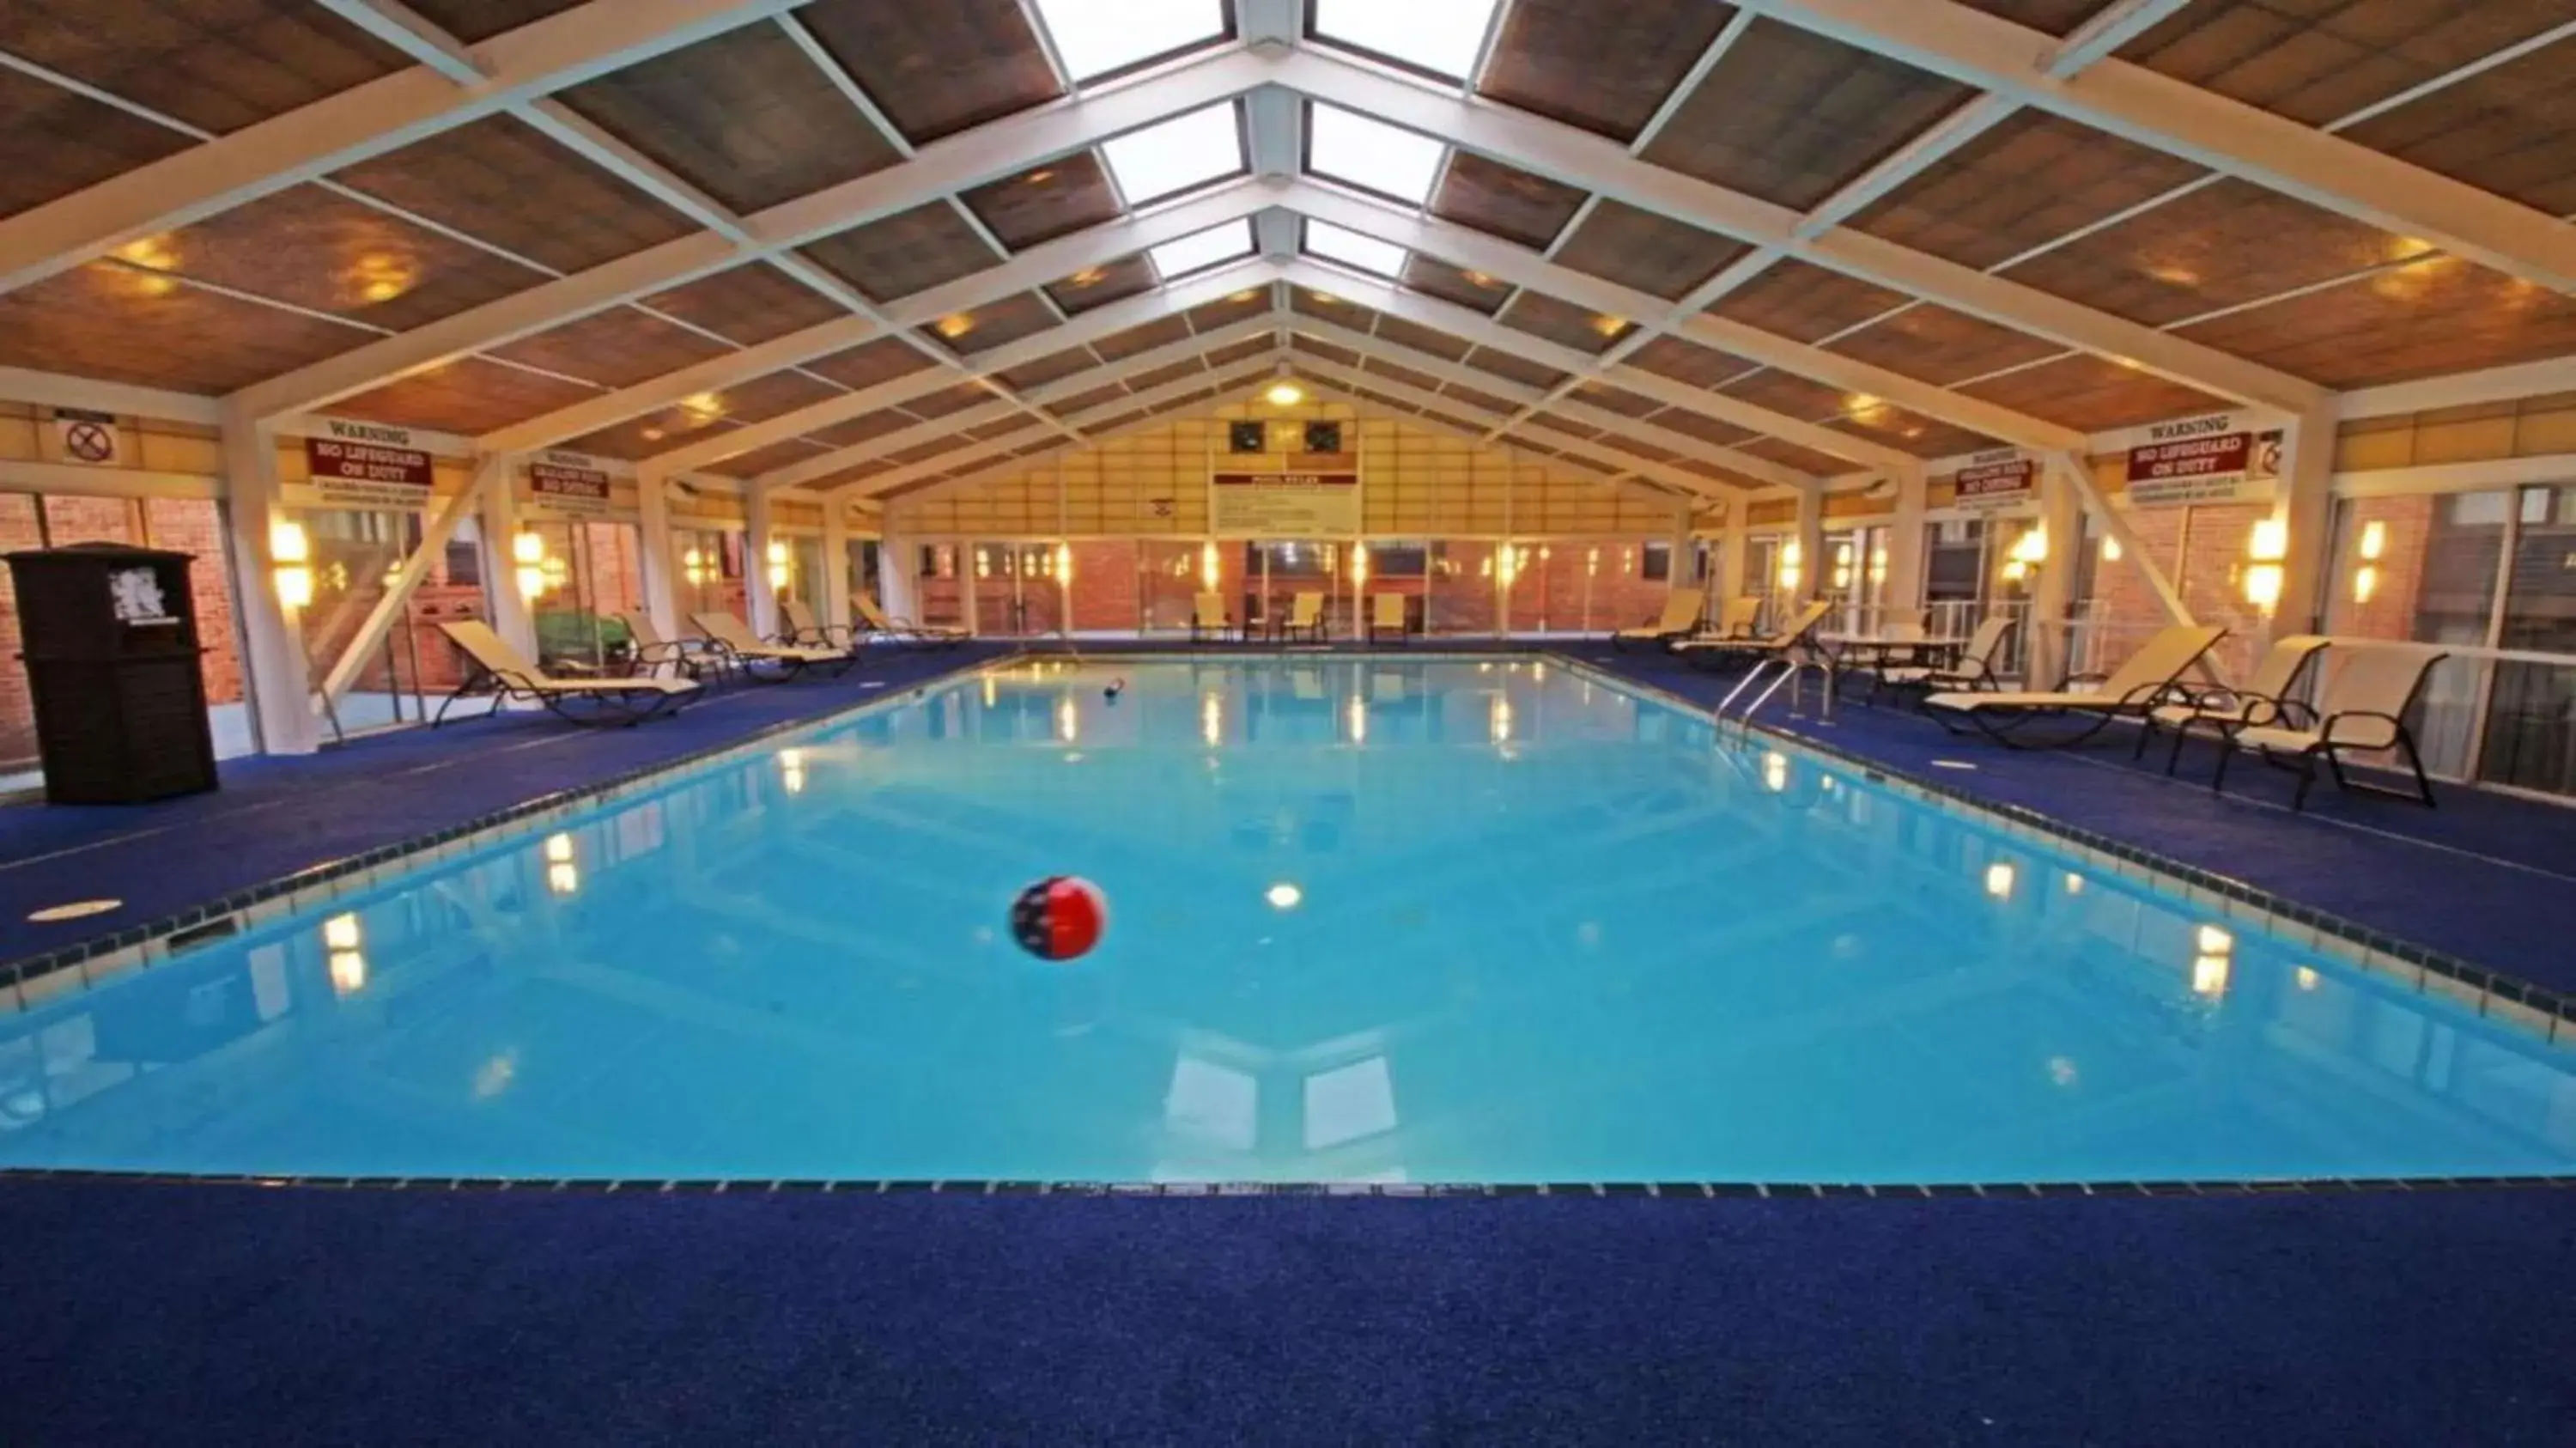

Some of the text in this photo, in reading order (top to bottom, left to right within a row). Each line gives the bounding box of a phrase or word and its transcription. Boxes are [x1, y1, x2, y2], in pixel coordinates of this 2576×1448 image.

[329, 420, 410, 445] WARNING
[2150, 416, 2230, 440] WARNING
[316, 442, 425, 467] NO LIFEGUARD
[2136, 436, 2242, 462] NO LIFEGUARD
[340, 461, 408, 481] ON DUTY
[2152, 457, 2219, 476] ON DUTY
